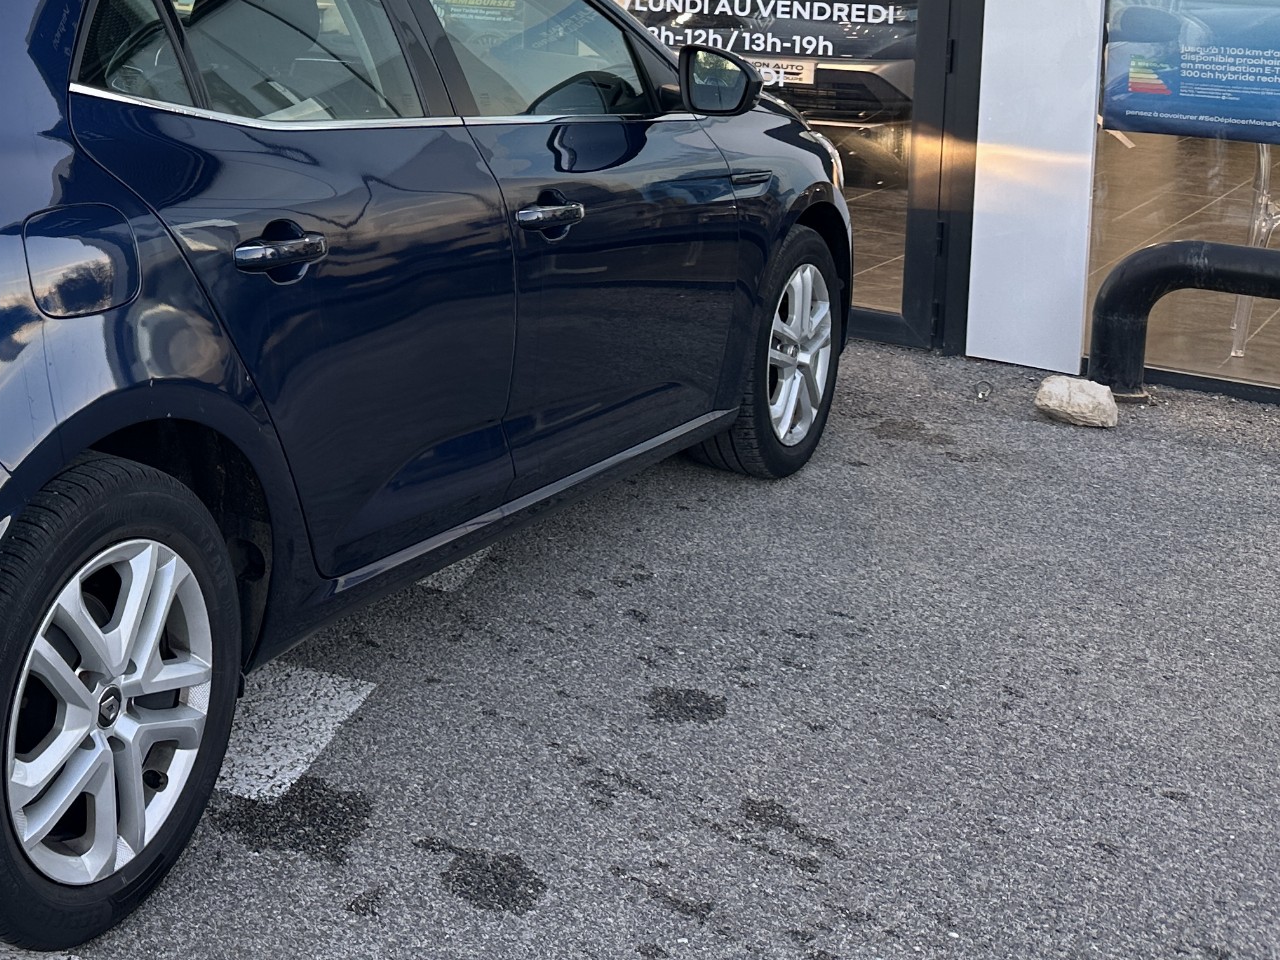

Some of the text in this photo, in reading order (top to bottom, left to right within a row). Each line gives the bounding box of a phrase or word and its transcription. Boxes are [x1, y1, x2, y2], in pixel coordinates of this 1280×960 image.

[757, 0, 894, 25] VENDREDI
[742, 33, 834, 56] 13h-19h
[1180, 44, 1218, 55] jusqu'à
[1245, 48, 1262, 56] km
[1181, 53, 1234, 63] disponible
[1194, 63, 1263, 73] motorisation
[1215, 72, 1256, 81] hybride
[1126, 109, 1152, 117] pensez
[1160, 112, 1197, 120] covoiturer
